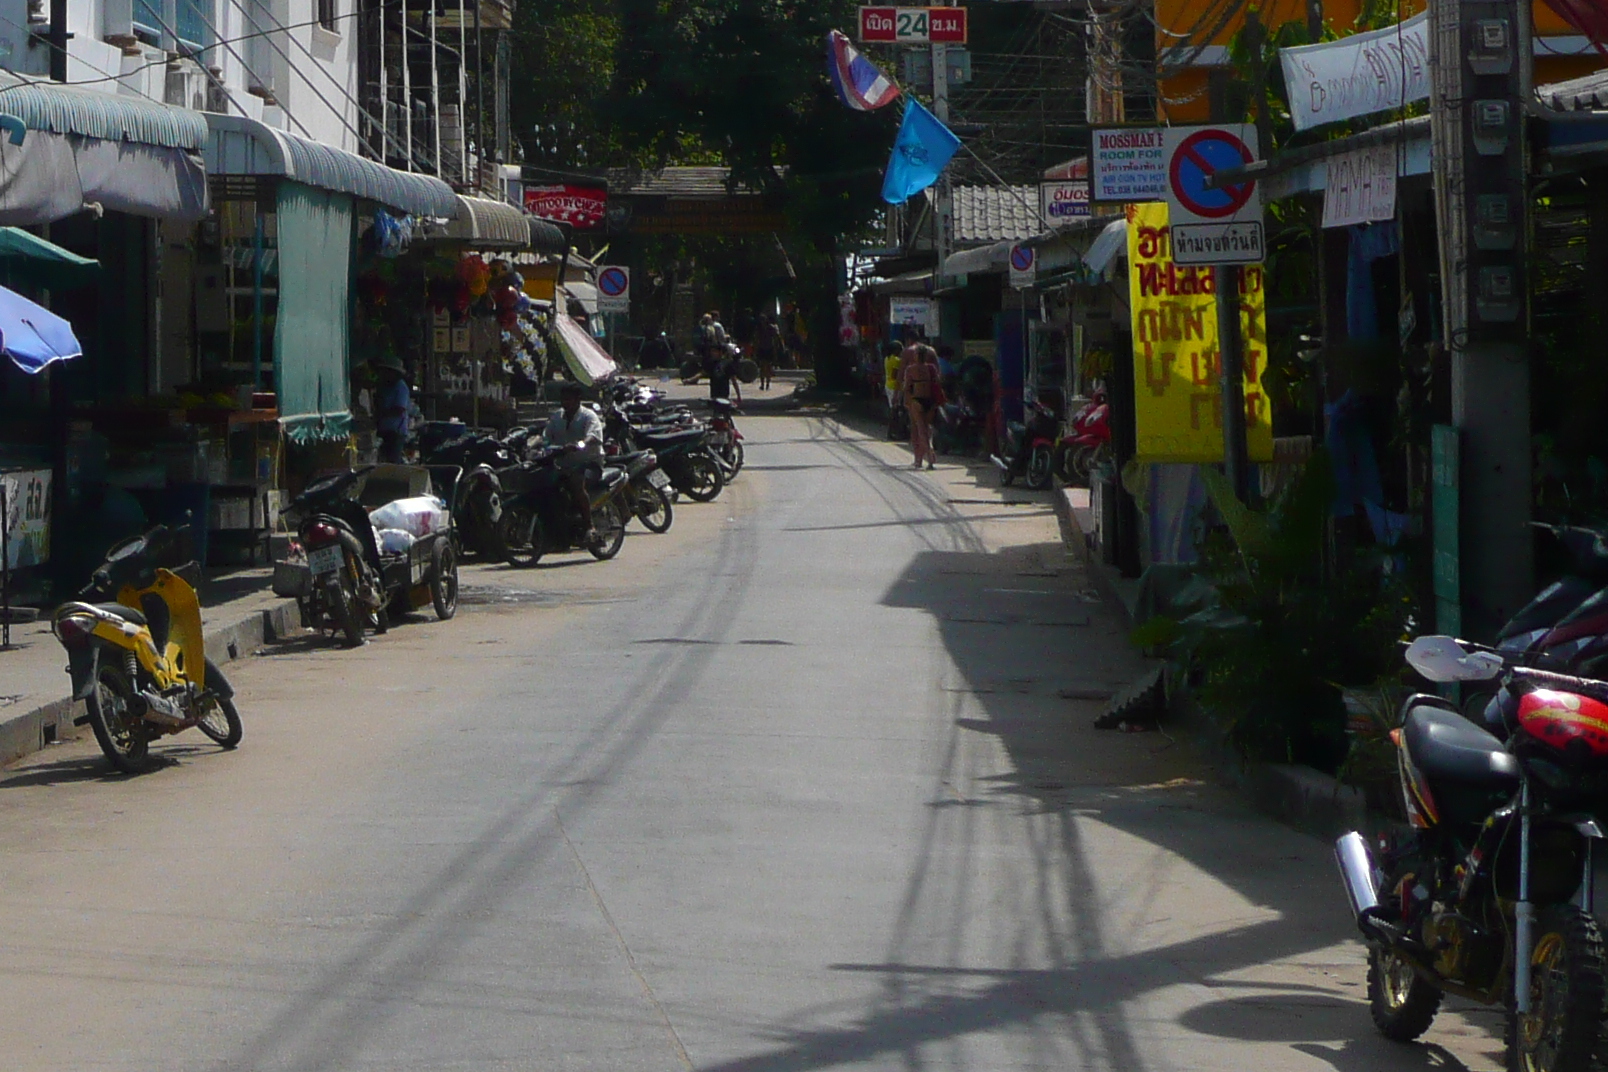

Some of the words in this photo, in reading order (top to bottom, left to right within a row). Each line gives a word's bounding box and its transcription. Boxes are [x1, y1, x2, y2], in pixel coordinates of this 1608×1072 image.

[866, 13, 893, 31] เปิด
[897, 13, 928, 36] 24
[1100, 133, 1155, 149] MOSSMAN
[1100, 151, 1135, 160] ROOM
[1139, 150, 1162, 159] FOR
[1177, 225, 1259, 253] ห้ามจอดวันคี่
